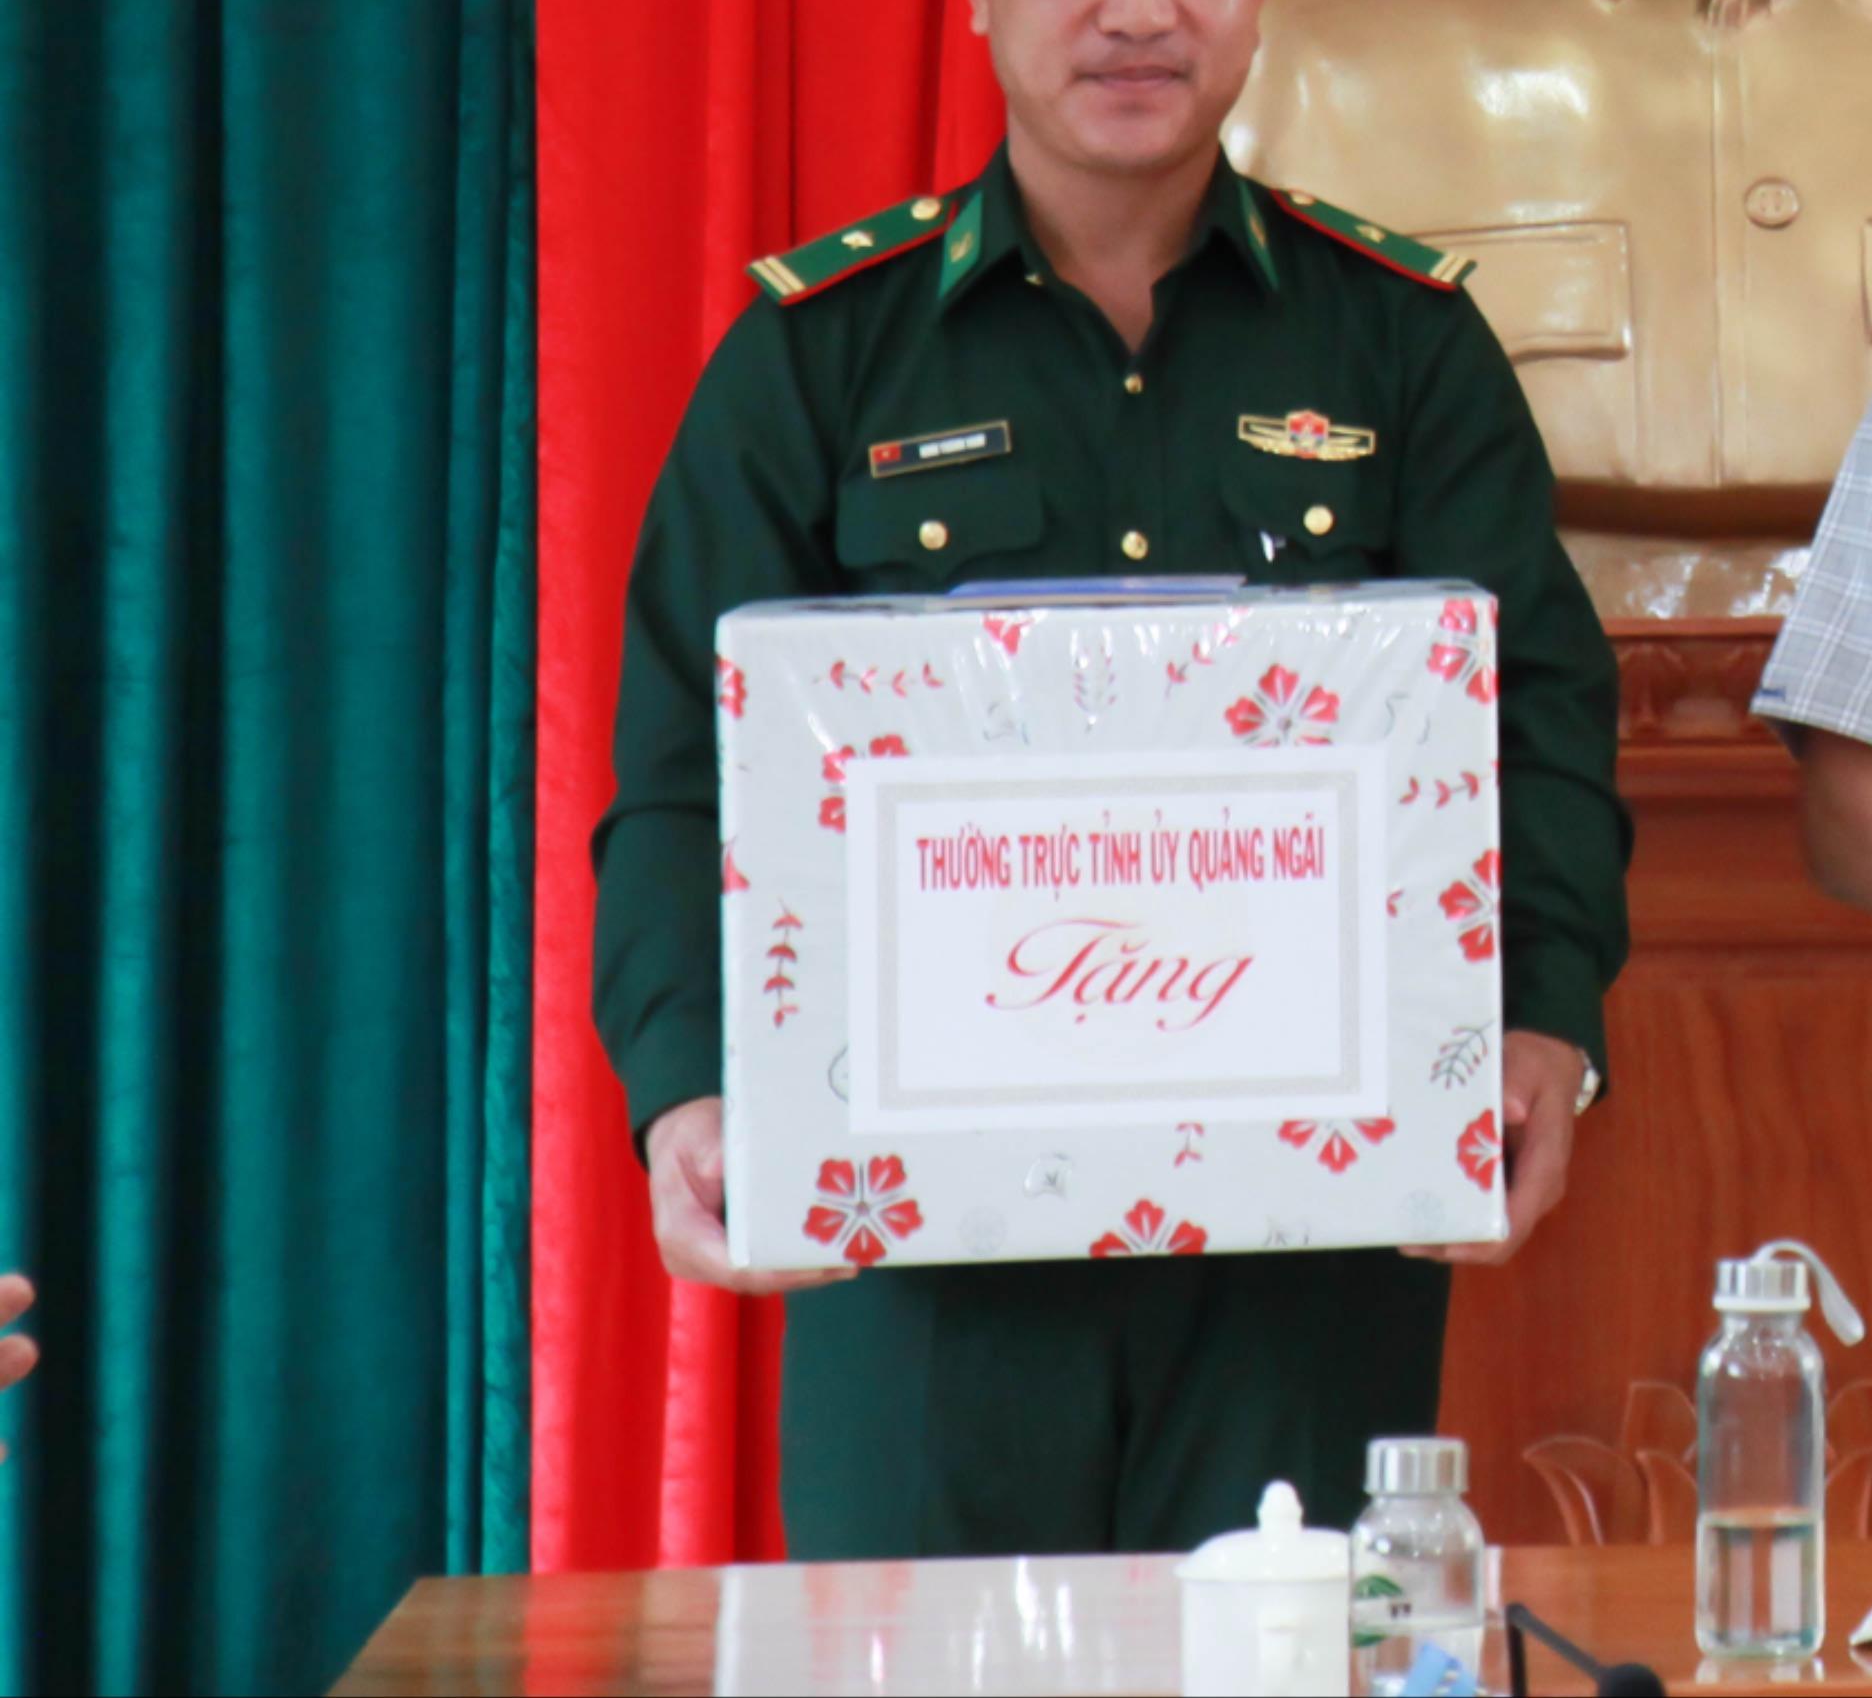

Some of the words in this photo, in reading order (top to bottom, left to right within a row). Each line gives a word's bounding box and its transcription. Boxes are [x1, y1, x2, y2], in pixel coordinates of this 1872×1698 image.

[916, 822, 1011, 891] THƯỜNG
[1019, 824, 1081, 901] TRỰC
[1088, 810, 1141, 886] TỈNH
[1150, 809, 1181, 884] ỦY
[1188, 807, 1265, 893] QUẢNG
[1273, 812, 1326, 880] NGÃI
[985, 918, 1254, 1032] Tặng
